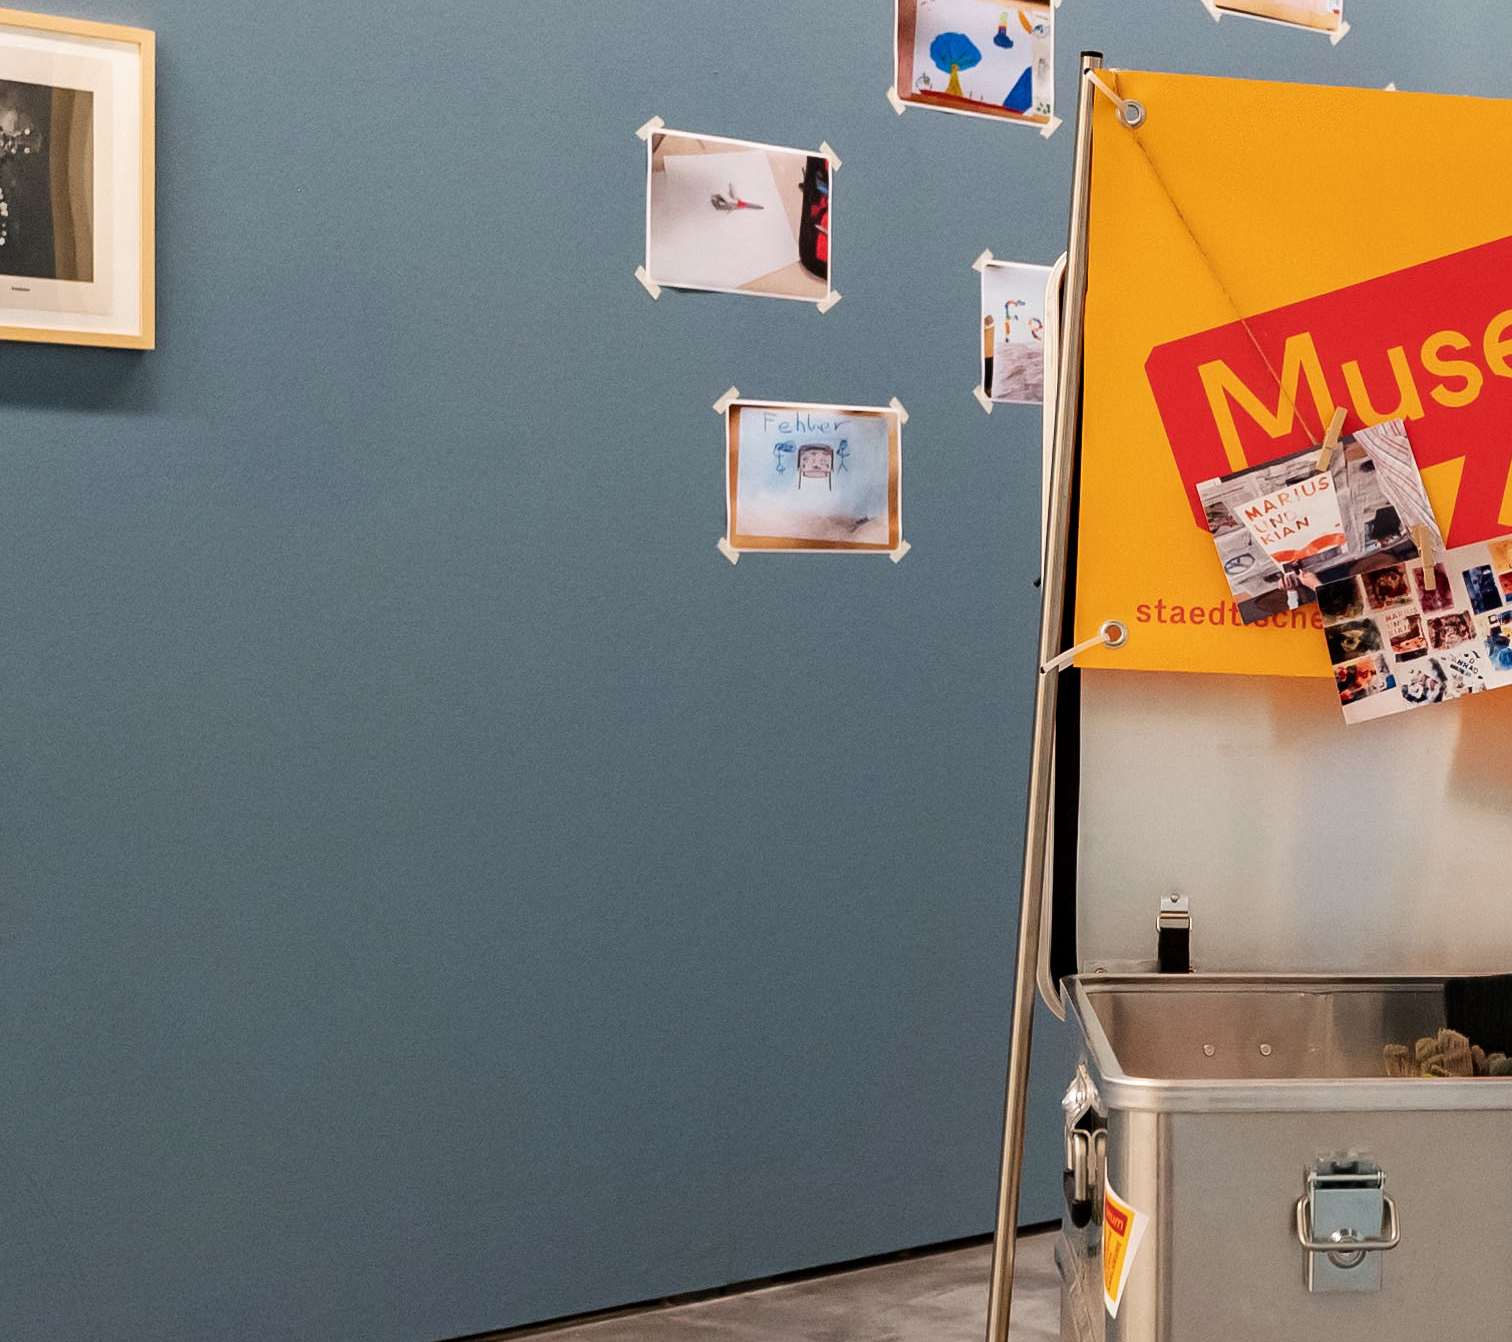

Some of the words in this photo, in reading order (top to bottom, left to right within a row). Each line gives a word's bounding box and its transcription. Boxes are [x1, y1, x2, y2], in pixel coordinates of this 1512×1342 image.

[1244, 476, 1330, 522] MARIUS
[1253, 511, 1298, 535] UND
[1260, 516, 1310, 546] KIAN
